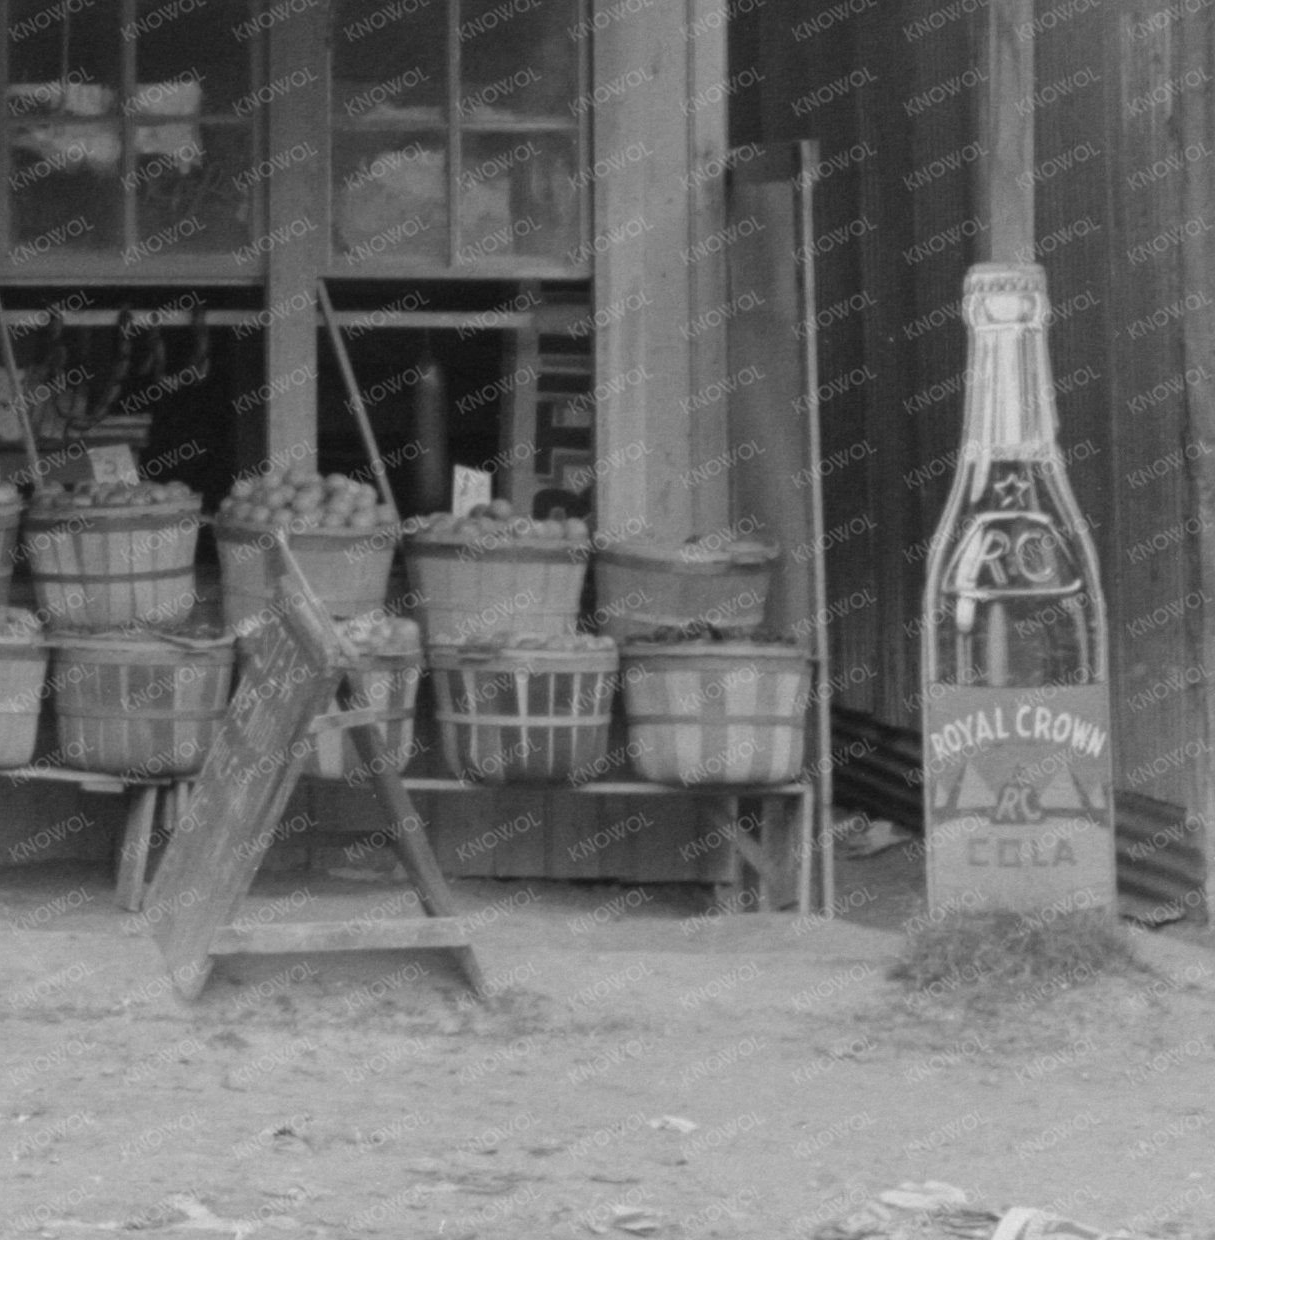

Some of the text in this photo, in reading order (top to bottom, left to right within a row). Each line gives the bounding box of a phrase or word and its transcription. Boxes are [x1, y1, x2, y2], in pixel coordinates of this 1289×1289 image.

[976, 529, 1055, 584] RC
[930, 704, 1107, 761] ROYAL CROWN
[967, 838, 1078, 868] COLA
